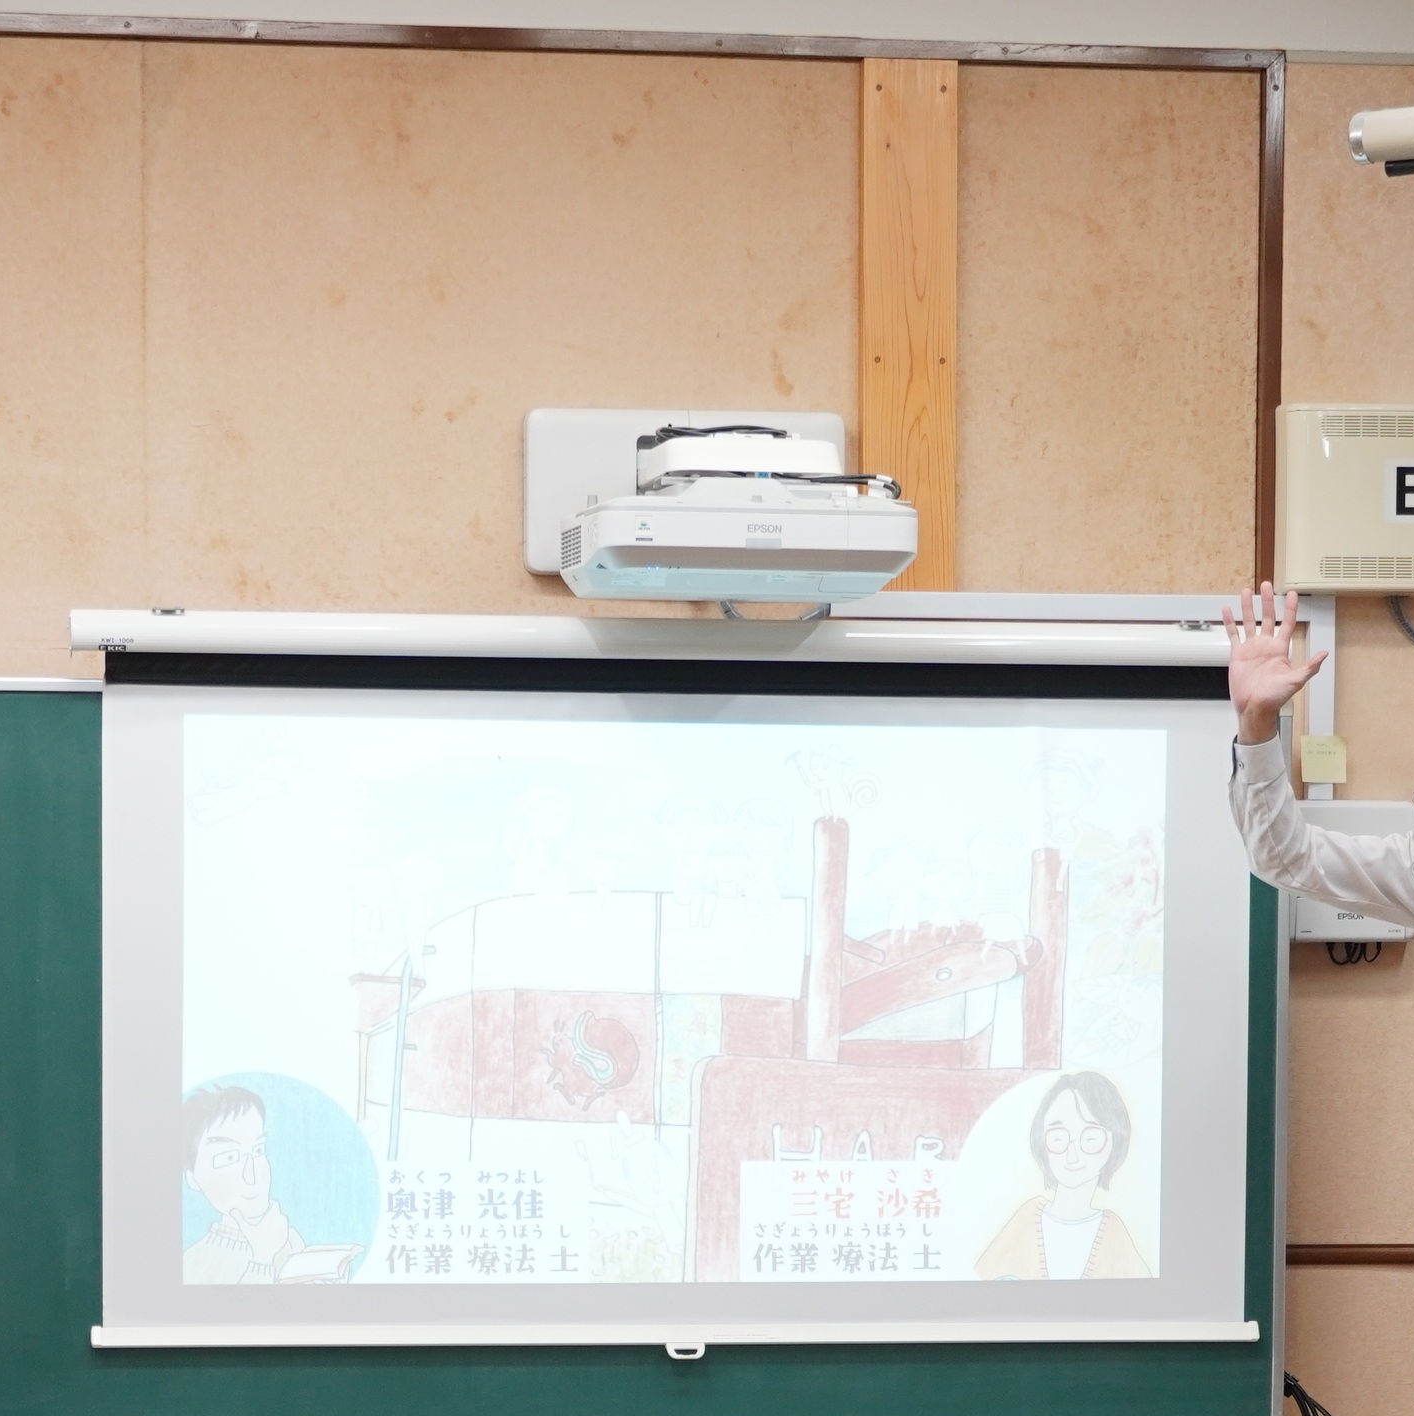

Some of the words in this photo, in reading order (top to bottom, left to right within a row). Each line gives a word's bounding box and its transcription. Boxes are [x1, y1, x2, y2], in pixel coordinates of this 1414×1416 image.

[747, 524, 782, 534] EPSON
[389, 1169, 452, 1185] おくつ
[477, 1169, 544, 1185] みつよし
[791, 1168, 855, 1184] みやけ
[886, 1168, 934, 1184] さき
[477, 1188, 544, 1220] 光佳
[791, 1187, 855, 1219] 三宅
[876, 1186, 942, 1219] 沙希
